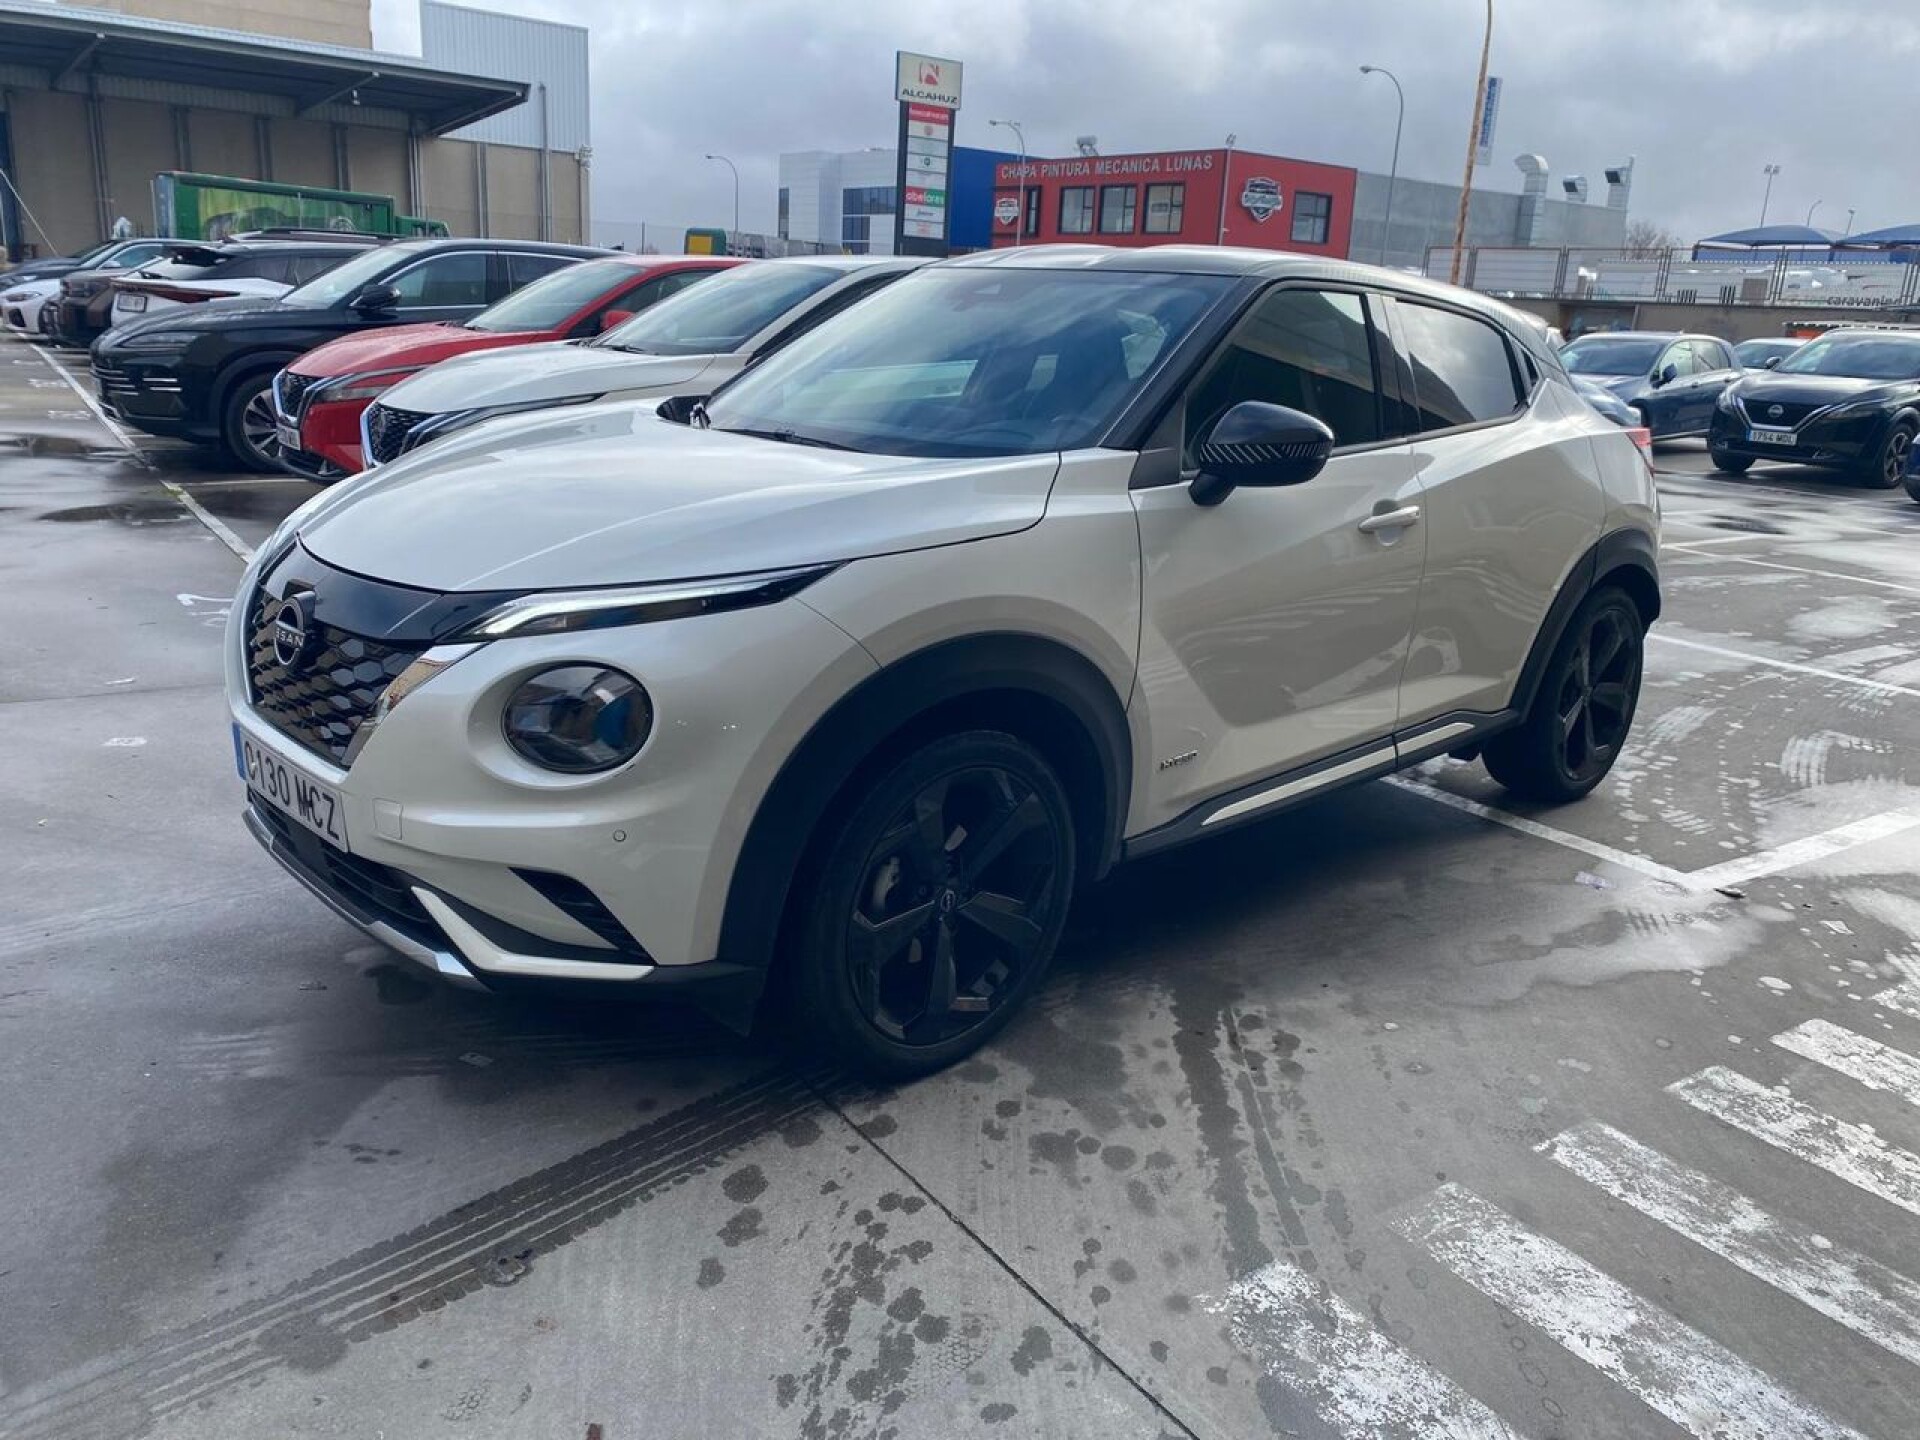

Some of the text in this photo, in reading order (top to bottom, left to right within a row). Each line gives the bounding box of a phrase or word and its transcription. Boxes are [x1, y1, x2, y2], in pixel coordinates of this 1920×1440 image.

[902, 88, 958, 104] ALCAHUZ
[1001, 154, 1214, 180] CHAPA PINTURA MECANICA LUNAS
[294, 773, 340, 841] MCZ
